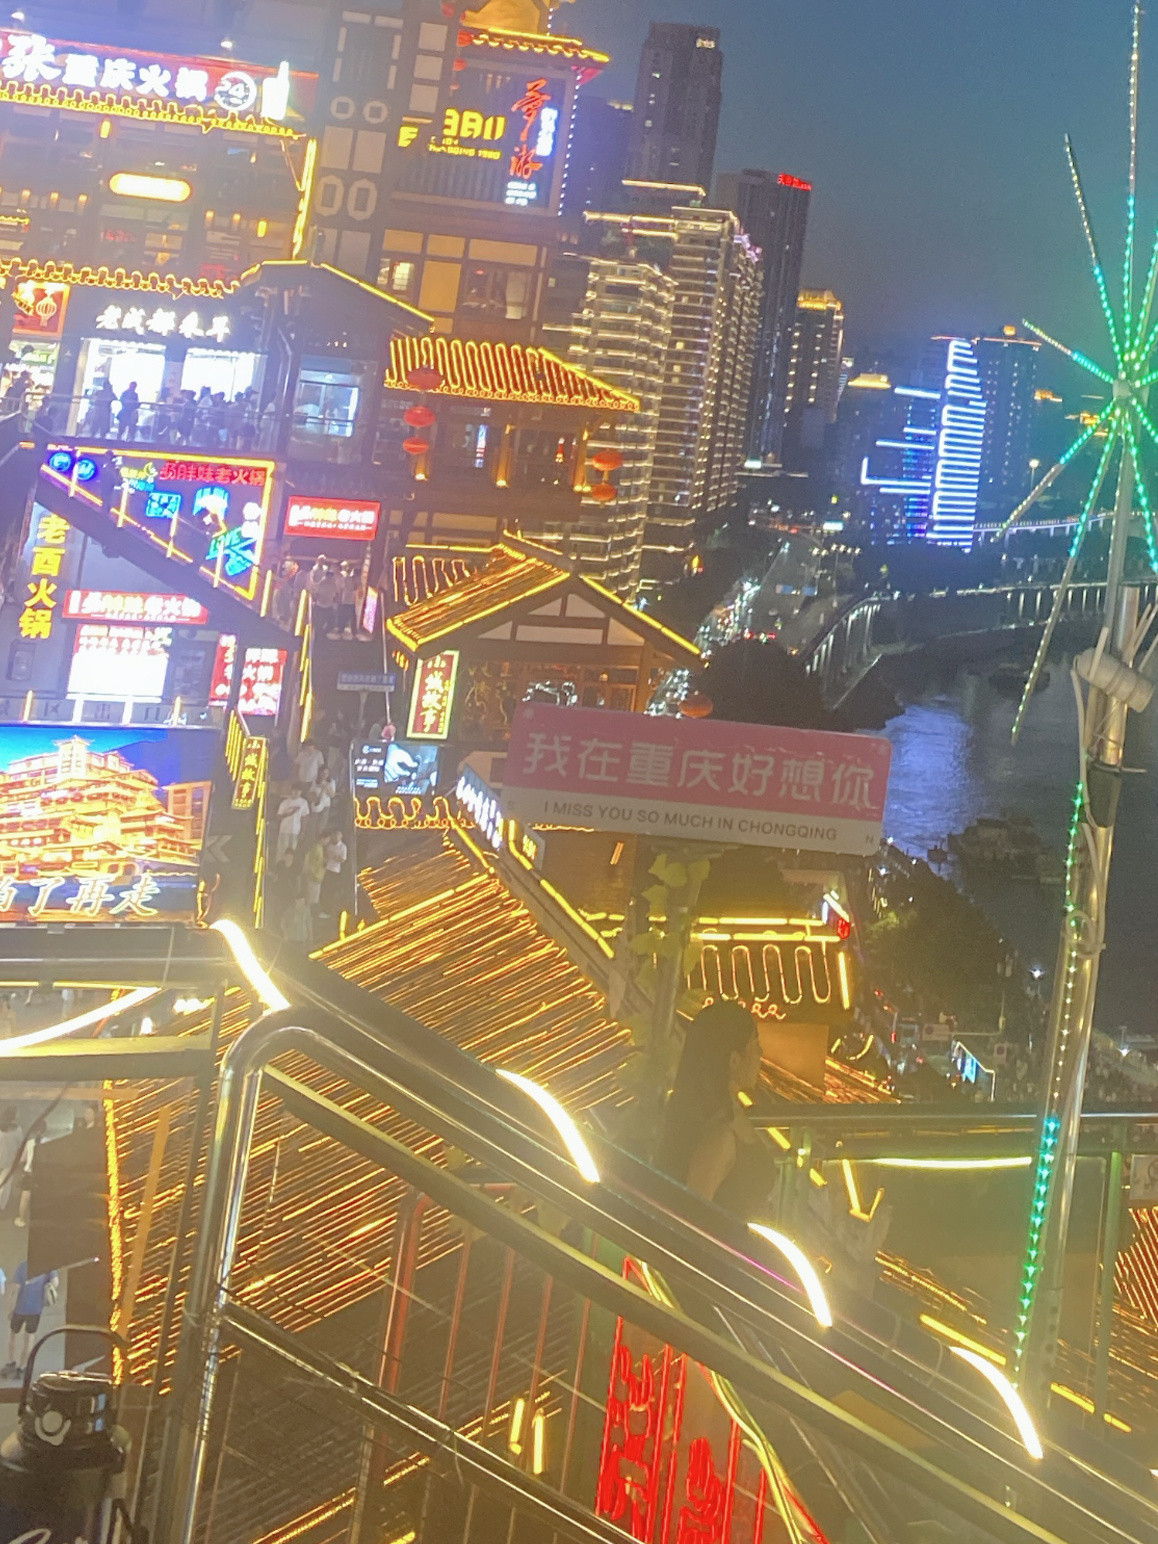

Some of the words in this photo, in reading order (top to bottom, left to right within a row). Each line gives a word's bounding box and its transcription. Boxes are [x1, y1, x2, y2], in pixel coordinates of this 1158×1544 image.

[522, 732, 879, 812] 我在重庆好想你
[552, 802, 594, 819] MISS
[598, 806, 632, 822] YOU
[637, 810, 660, 825] SO
[664, 813, 713, 830] MUCH
[717, 818, 734, 831] IN
[737, 819, 838, 842] CHONGQING
